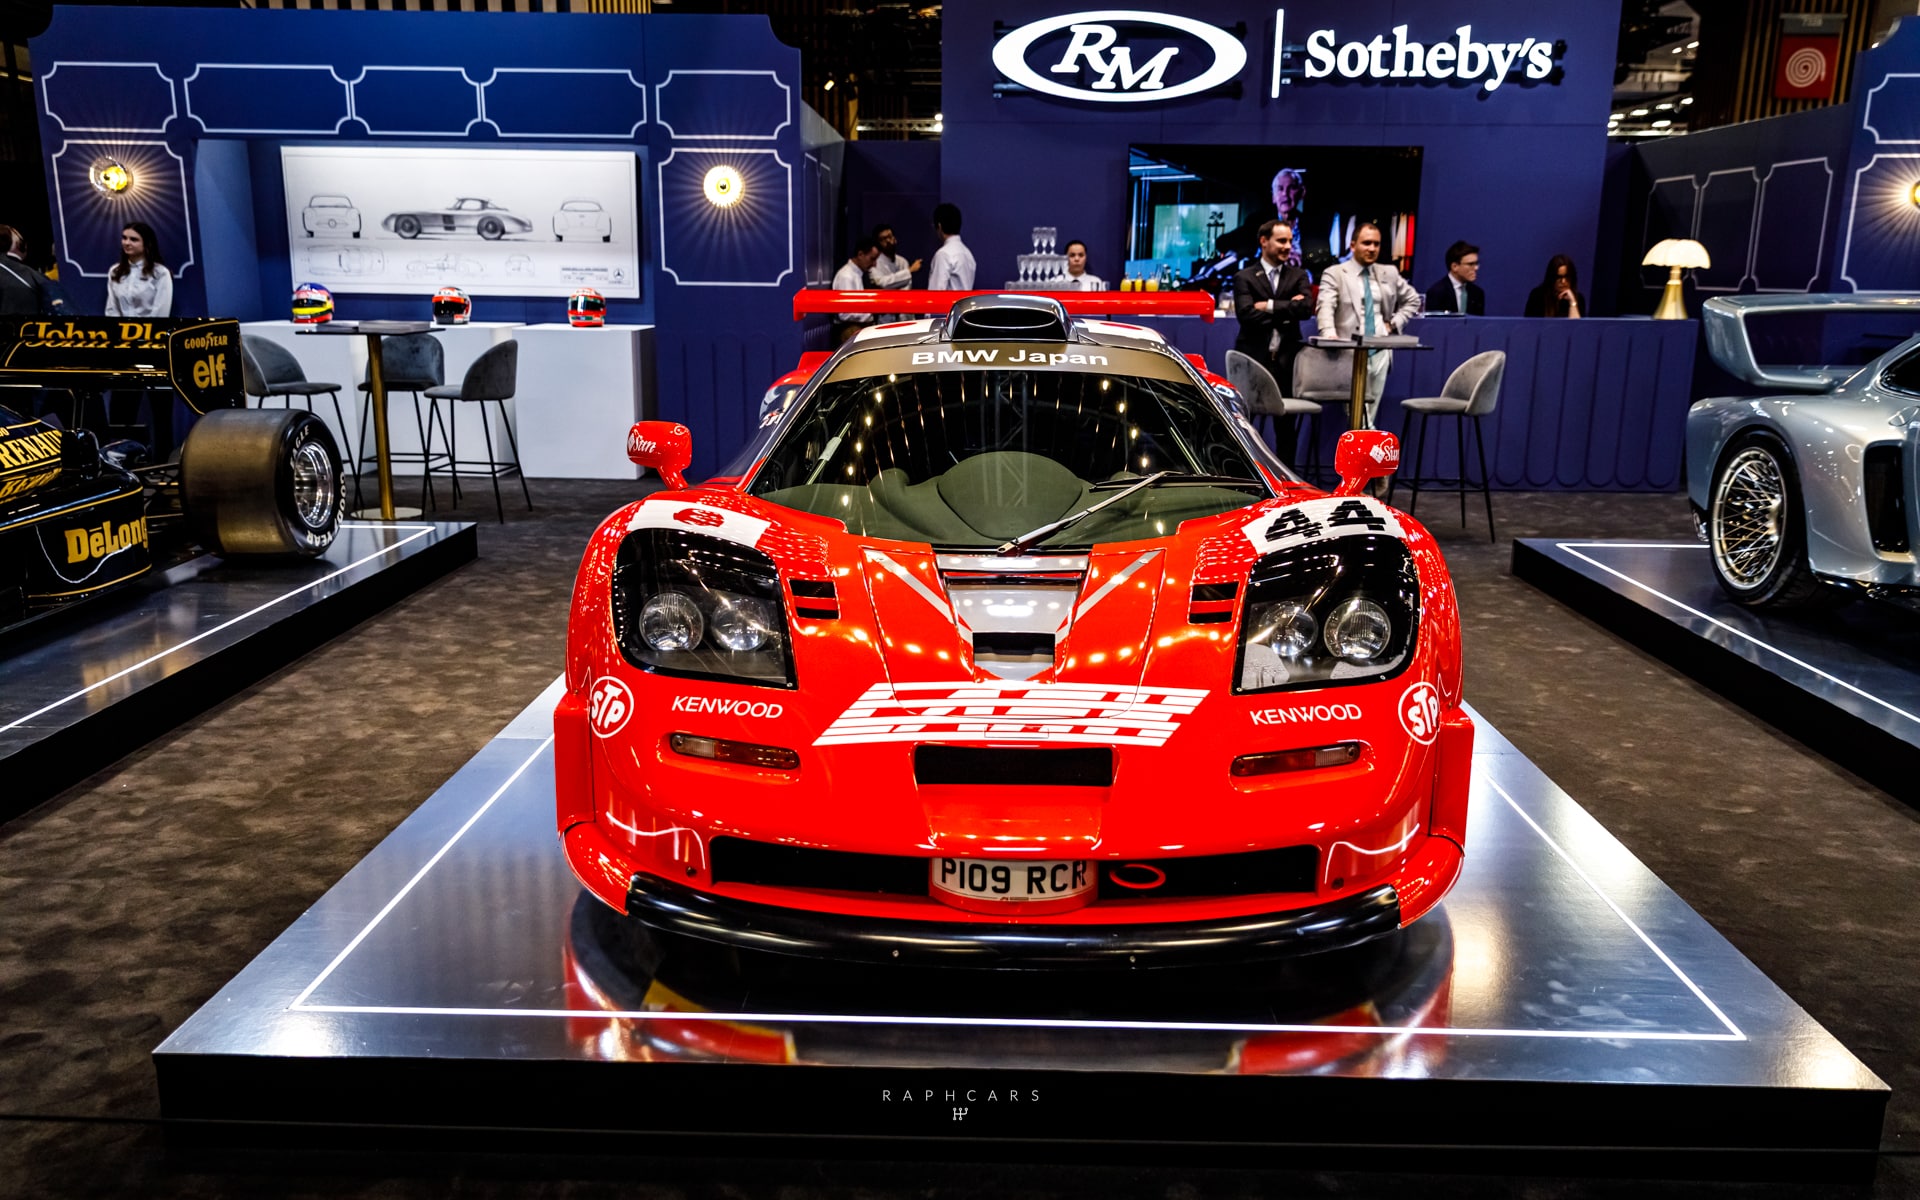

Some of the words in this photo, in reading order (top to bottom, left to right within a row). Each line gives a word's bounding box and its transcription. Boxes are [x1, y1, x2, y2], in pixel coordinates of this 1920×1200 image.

[1050, 23, 1180, 91] RM
[1303, 23, 1554, 93] Sotheby's
[25, 321, 111, 348] John
[192, 353, 227, 388] elf
[911, 349, 999, 366] BMW
[1008, 349, 1109, 366] Japan
[1264, 500, 1387, 543] 44
[591, 683, 626, 729] STP
[671, 695, 784, 719] KENWOOD
[1249, 703, 1363, 726] KENWOOD
[1407, 685, 1439, 737] STP
[1026, 860, 1087, 894] RCR
